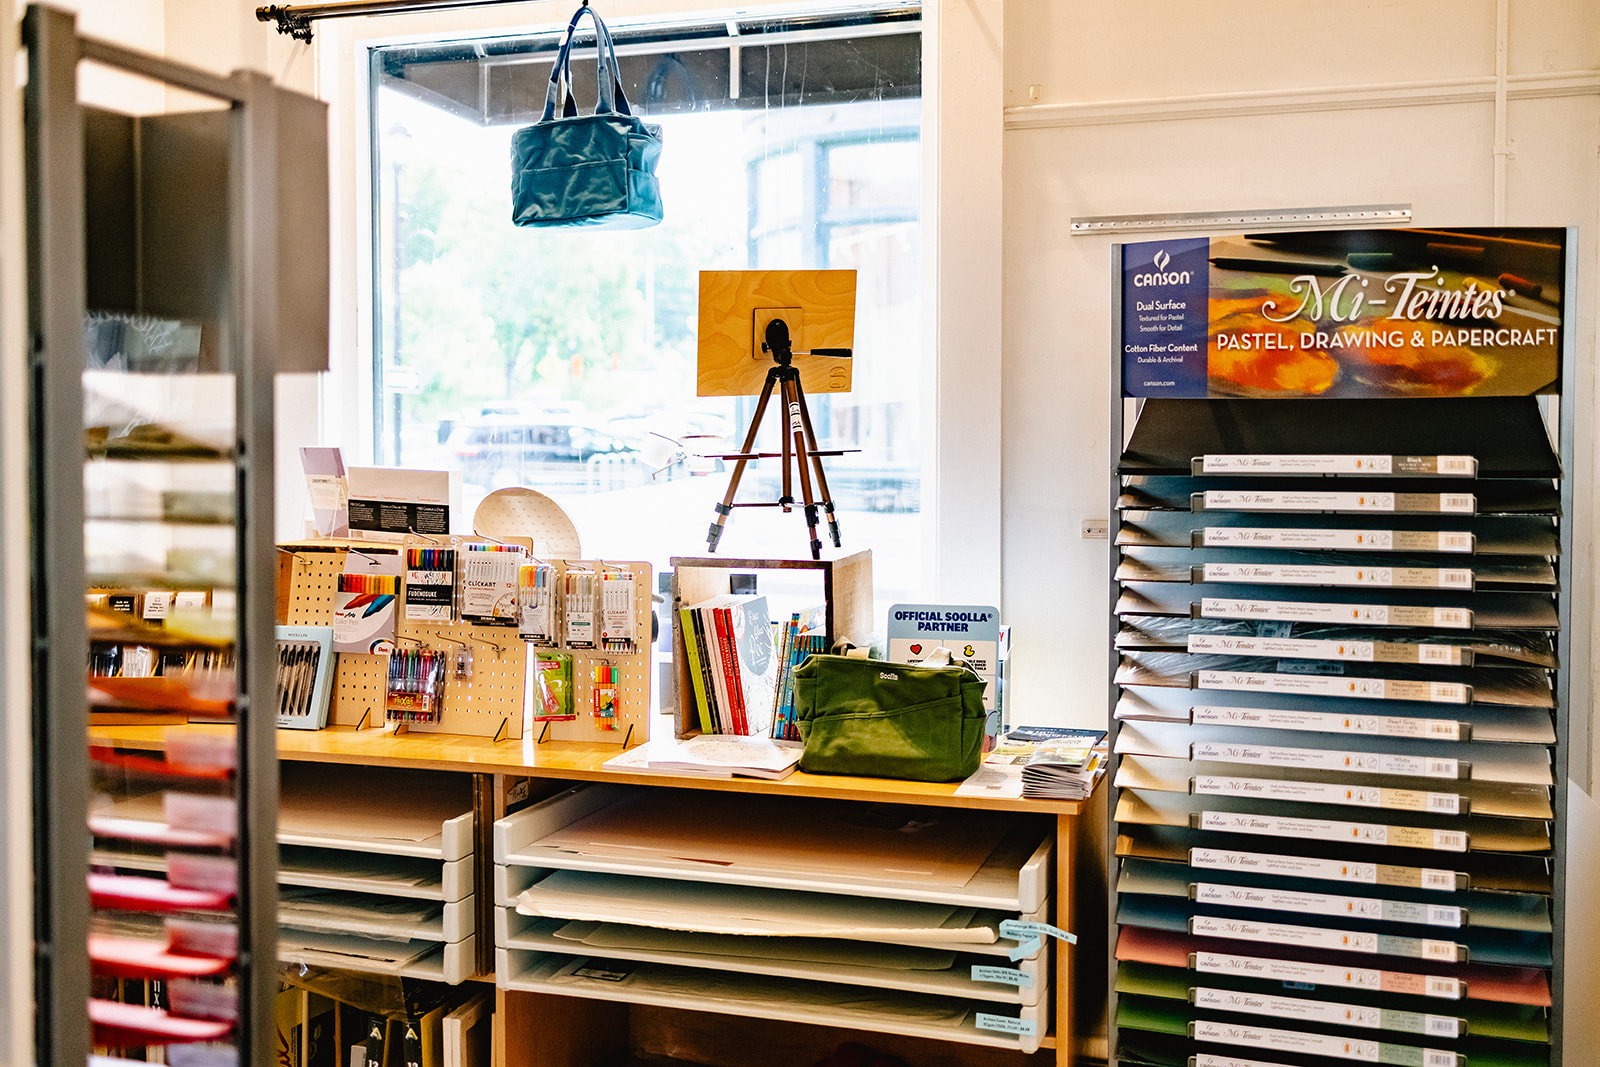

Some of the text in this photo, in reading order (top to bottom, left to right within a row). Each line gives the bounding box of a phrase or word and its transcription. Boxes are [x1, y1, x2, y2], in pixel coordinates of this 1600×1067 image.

[1137, 299, 1186, 311] Dual Surface
[1139, 314, 1160, 322] Textured
[1168, 313, 1185, 321] Pastel
[1159, 324, 1167, 332] for
[1216, 327, 1557, 353] PASTEL, DRAWING & PAPERCRAFT
[1125, 343, 1198, 353] Cotton Fiber Content
[894, 611, 942, 621] OFFICIAL
[918, 622, 968, 632] PARTNER
